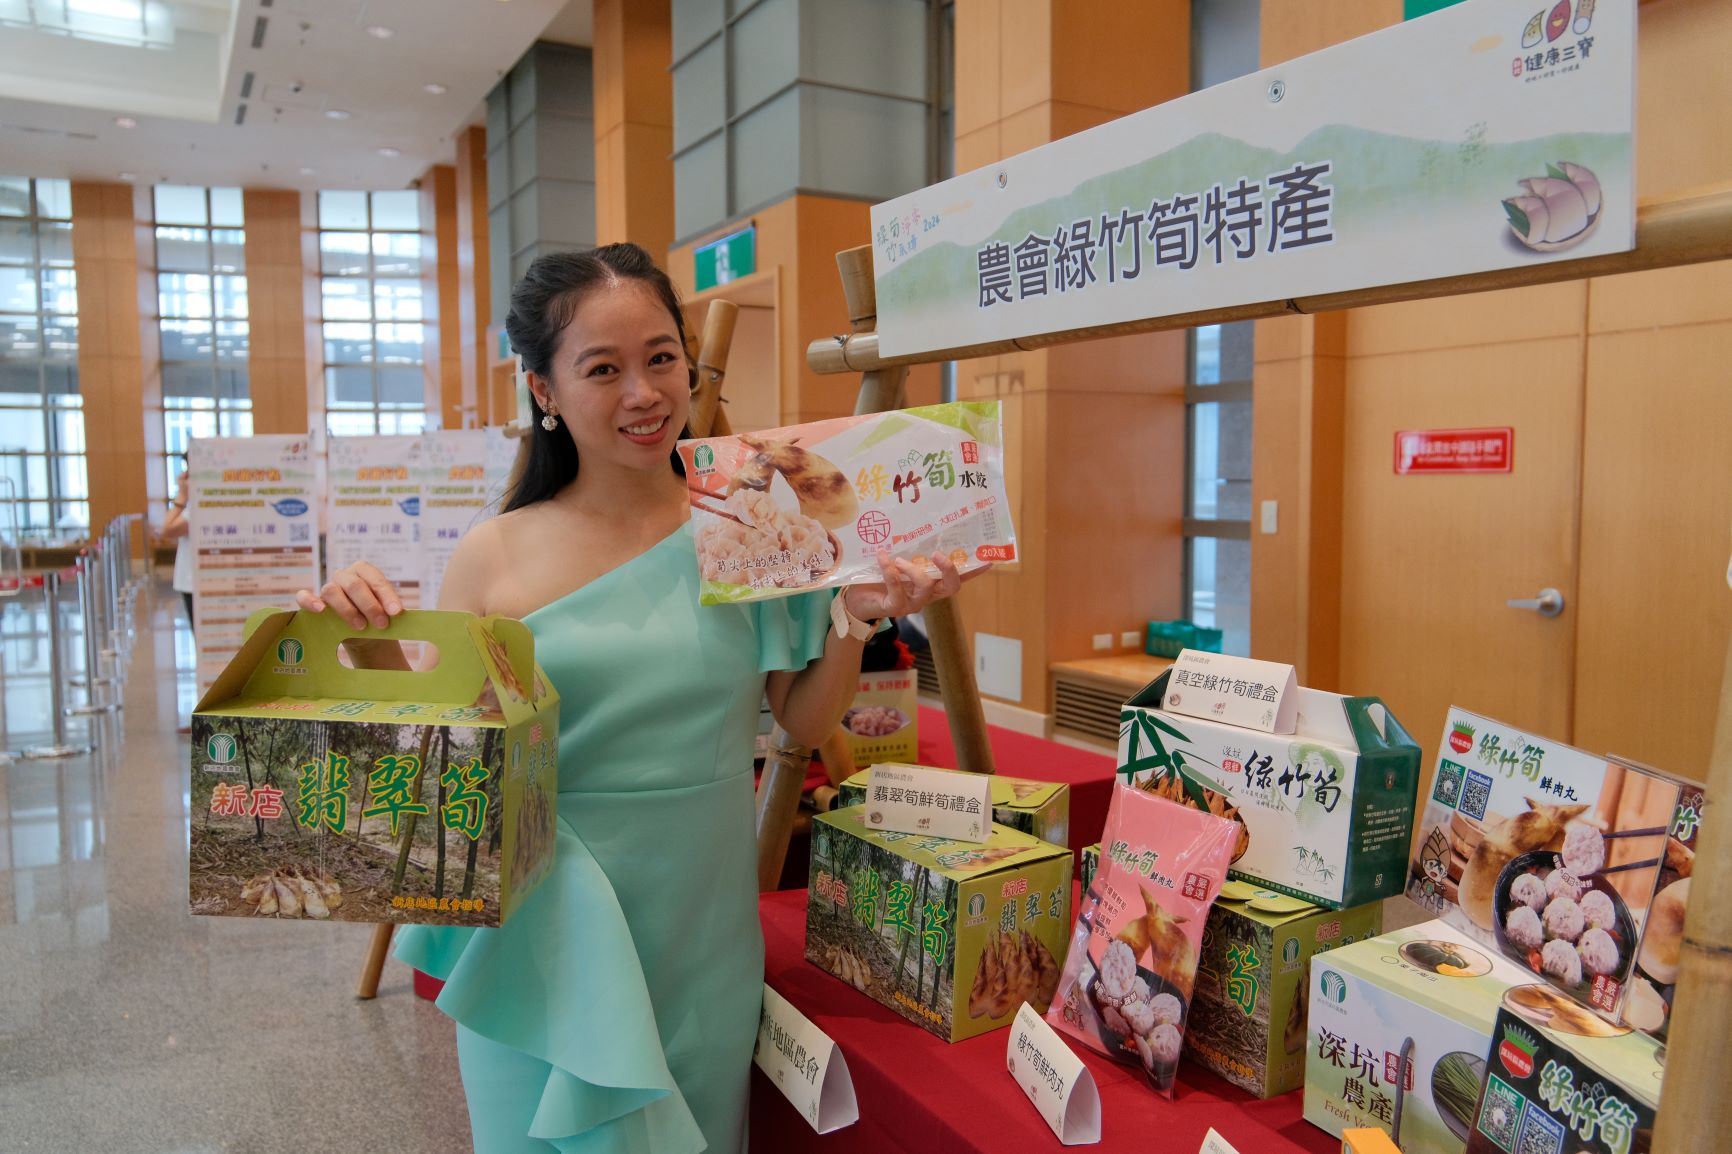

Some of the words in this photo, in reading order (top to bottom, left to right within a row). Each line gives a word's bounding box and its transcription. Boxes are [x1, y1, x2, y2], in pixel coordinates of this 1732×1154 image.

[977, 163, 1334, 309] 農會綠竹筍特產
[855, 449, 956, 504] 綠竹筍
[959, 470, 988, 489] 水餃
[1175, 669, 1279, 702] 真空綠竹筍禮盒
[1444, 761, 1462, 775] LINE
[1477, 732, 1545, 782] 綠竹筍
[1539, 776, 1578, 801] 鮮肉丸
[210, 783, 284, 818] 新店
[297, 750, 491, 840] 翡翠筍
[873, 785, 981, 815] 翡翠筍鮮筍禮盒
[1002, 878, 1028, 898] 新店
[1149, 871, 1174, 889] 鮮肉丸
[816, 870, 848, 907] 新店
[853, 865, 949, 966] 翡翠筍
[1000, 886, 1062, 933] 翡翠筍
[1017, 1031, 1065, 1101] 綠竹筍鮮肉丸
[1318, 1025, 1380, 1088] 深坑
[1324, 1099, 1350, 1122] Fresh
[1342, 1076, 1394, 1126] 農產
[1494, 1081, 1519, 1105] LINE
[1538, 1058, 1639, 1154] 綠竹筍
[1528, 1105, 1561, 1137] facebook
